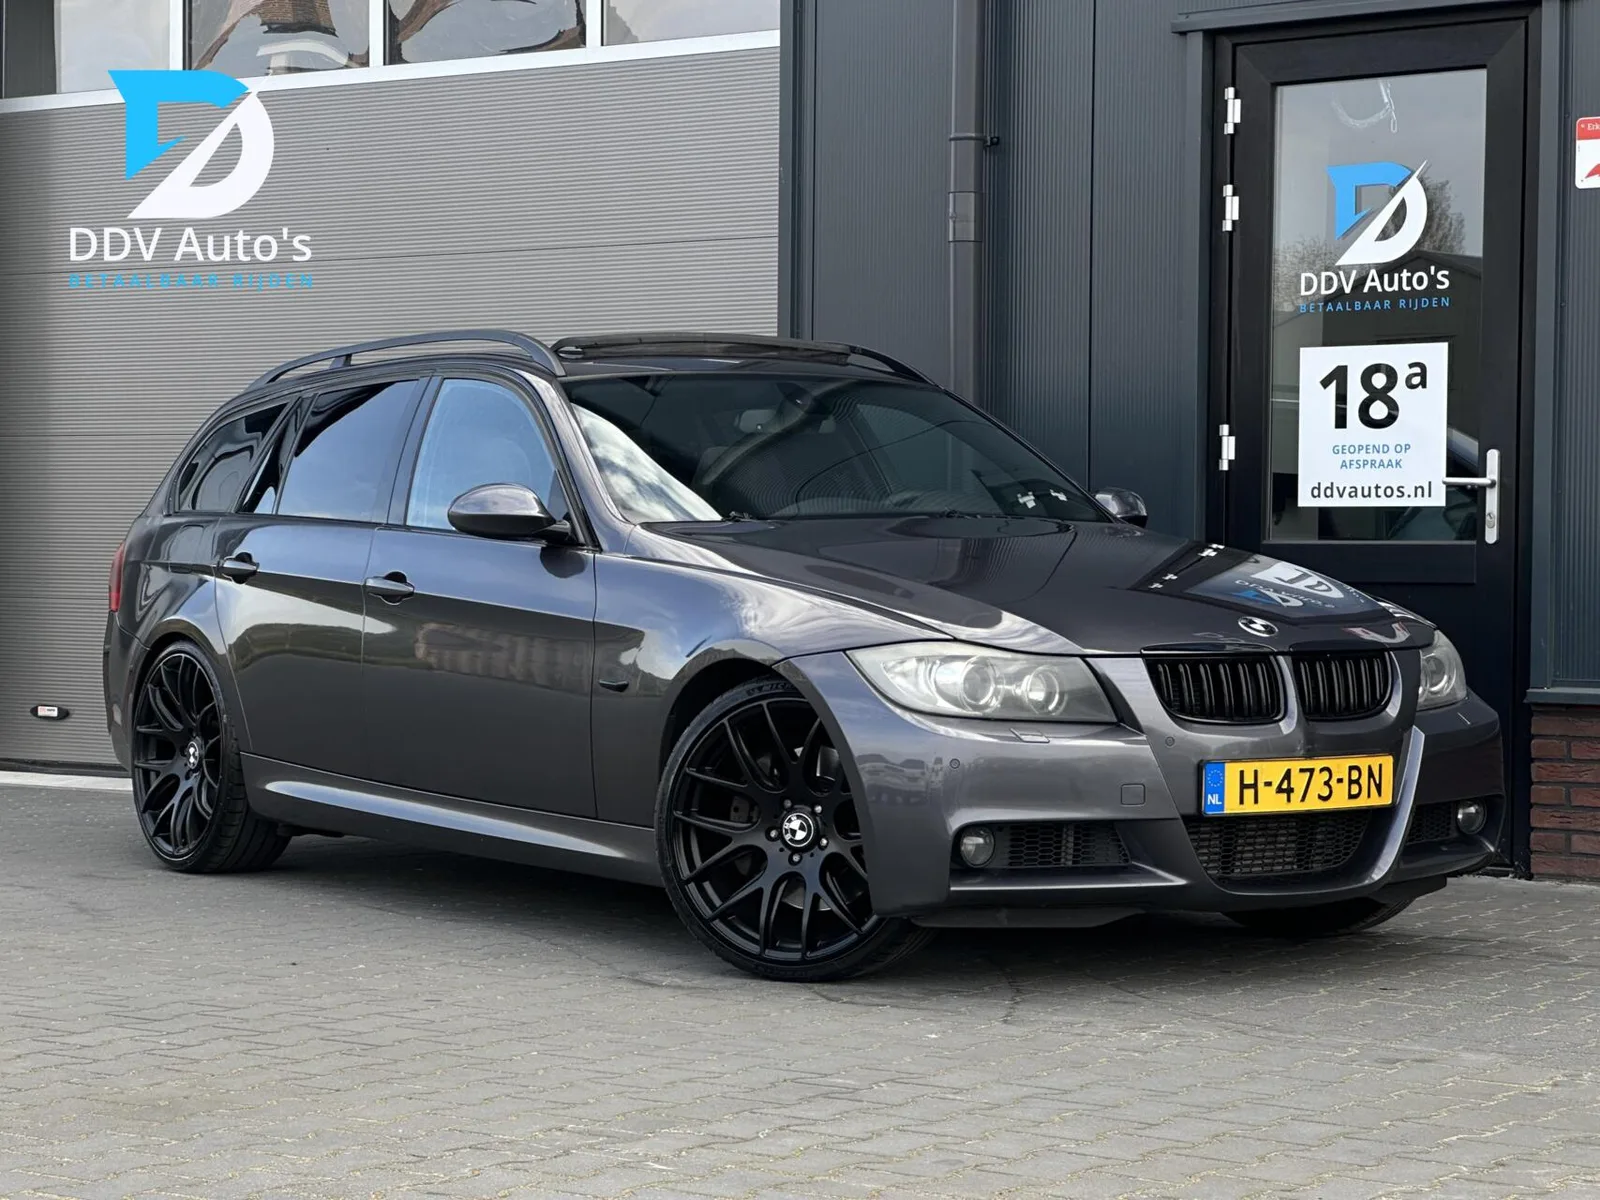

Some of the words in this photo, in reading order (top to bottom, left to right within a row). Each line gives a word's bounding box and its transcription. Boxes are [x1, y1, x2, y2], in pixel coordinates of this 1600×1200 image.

[1300, 270, 1357, 296] DDV
[1364, 265, 1450, 293] Auto's
[1299, 300, 1391, 313] BETAALBAAR
[1399, 297, 1450, 310] RIJDEN
[1332, 443, 1390, 455] GEOPEND
[1394, 443, 1411, 454] OP
[1340, 459, 1402, 470] AFSPRAAK
[1310, 481, 1432, 499] ddvautos.nl
[1239, 763, 1383, 805] H-473-BN
[1207, 794, 1222, 805] NL
